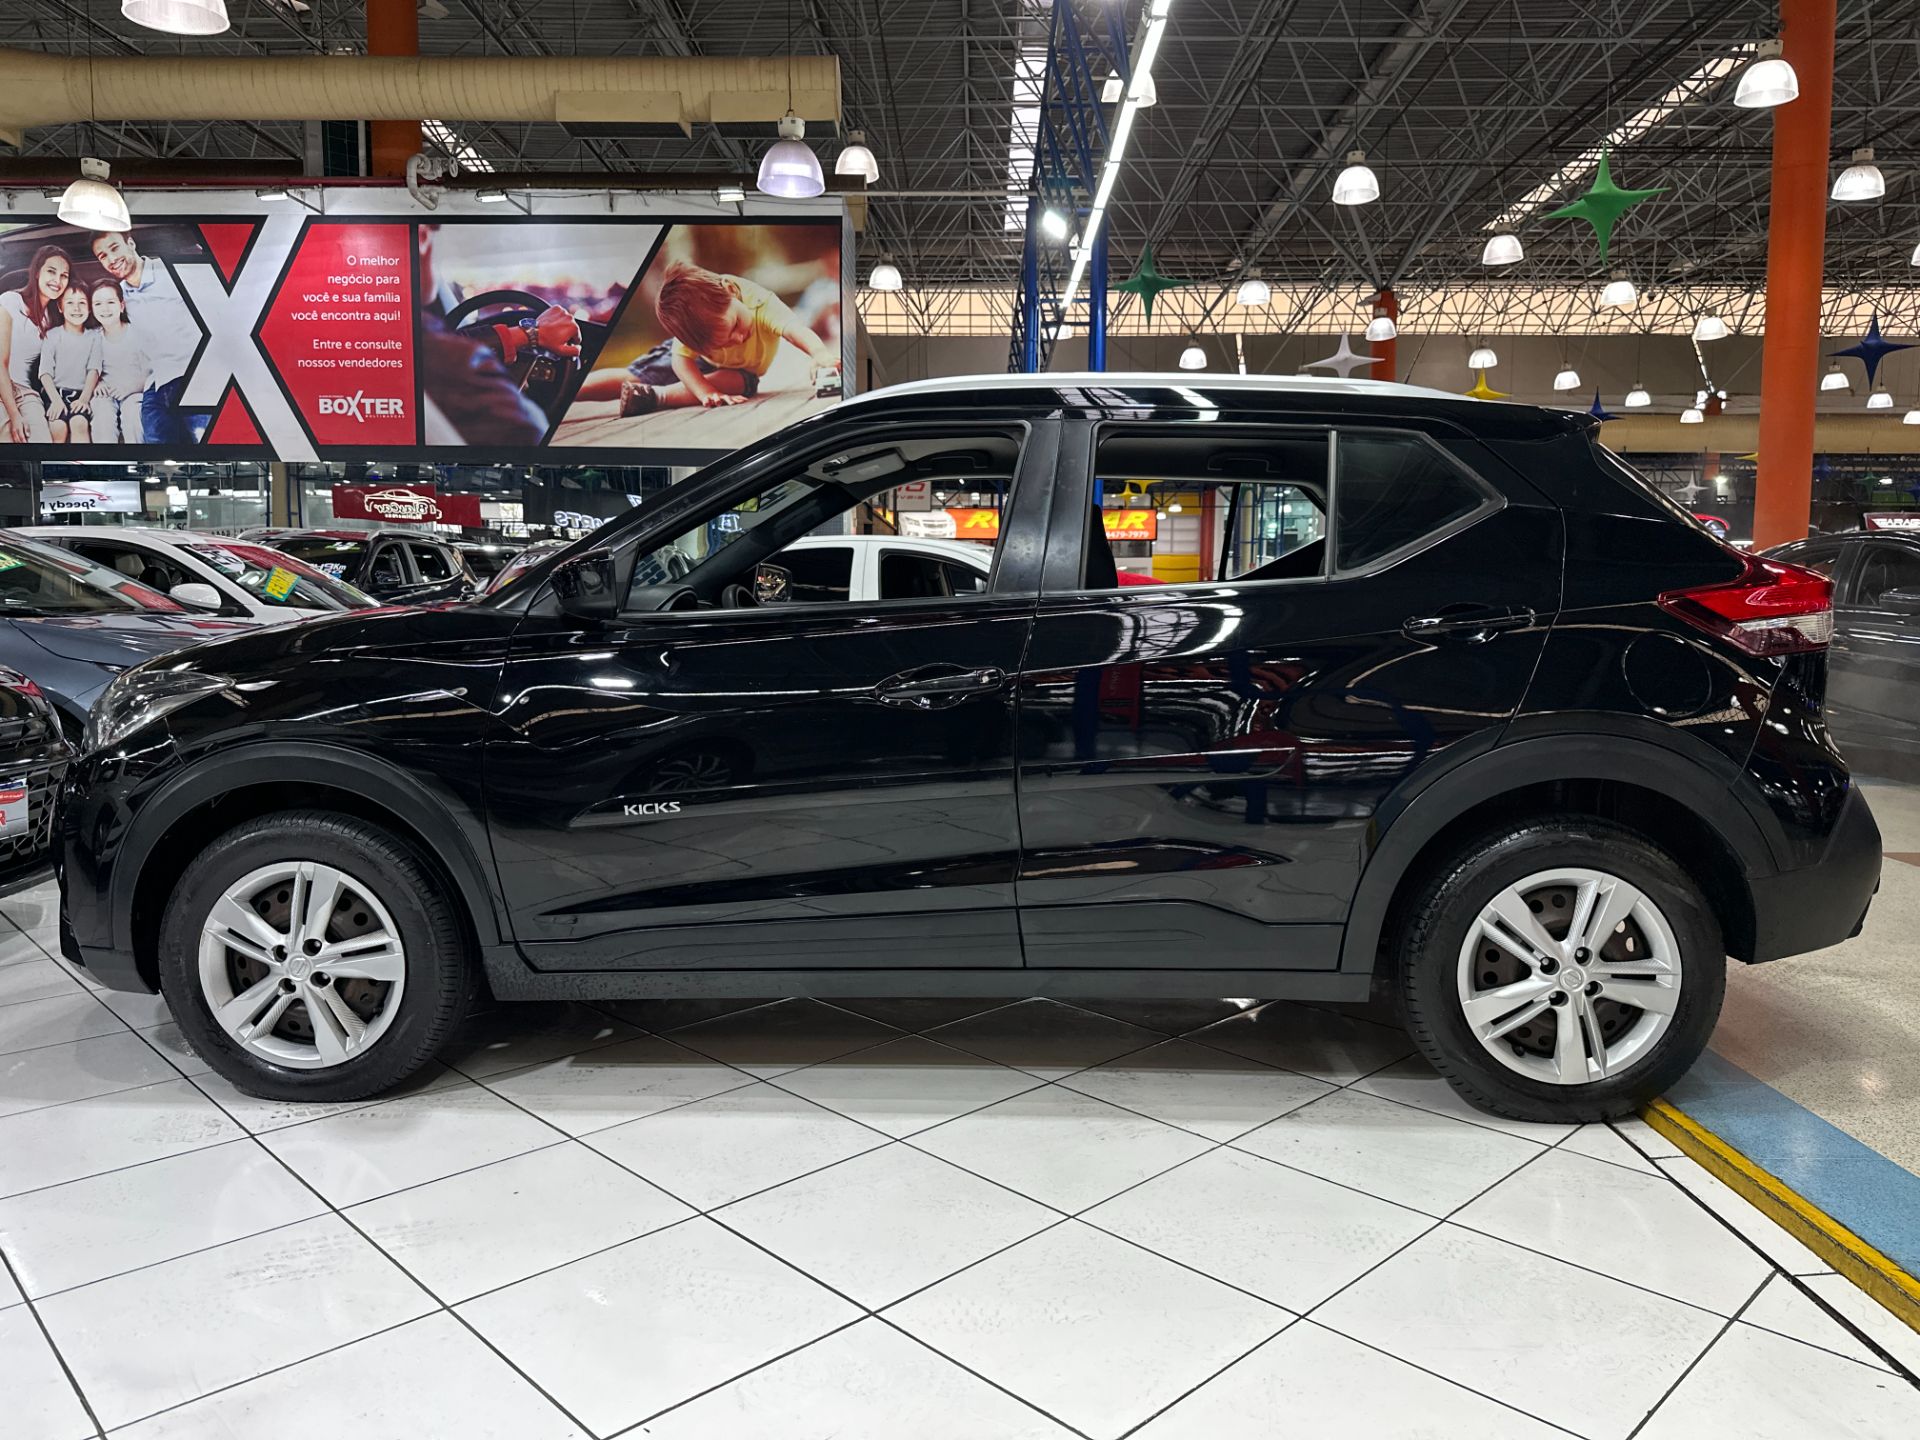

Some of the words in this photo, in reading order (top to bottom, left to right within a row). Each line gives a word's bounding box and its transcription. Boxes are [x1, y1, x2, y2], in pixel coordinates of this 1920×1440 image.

[347, 255, 356, 266] O
[360, 255, 400, 266] melhor
[327, 274, 373, 286] negócio
[375, 276, 400, 286] para
[302, 292, 330, 303] você
[332, 295, 339, 303] e
[342, 295, 361, 303] sua
[364, 292, 400, 303] família
[291, 310, 318, 321] você
[321, 311, 371, 321] encontra
[373, 311, 401, 322] aqui!
[313, 339, 342, 350] Entre
[345, 342, 352, 350] e
[354, 339, 402, 350] consulte
[297, 359, 336, 368] nossos
[338, 357, 403, 368] vendedores
[318, 390, 404, 423] BOXTER
[623, 801, 681, 816] KICKS
